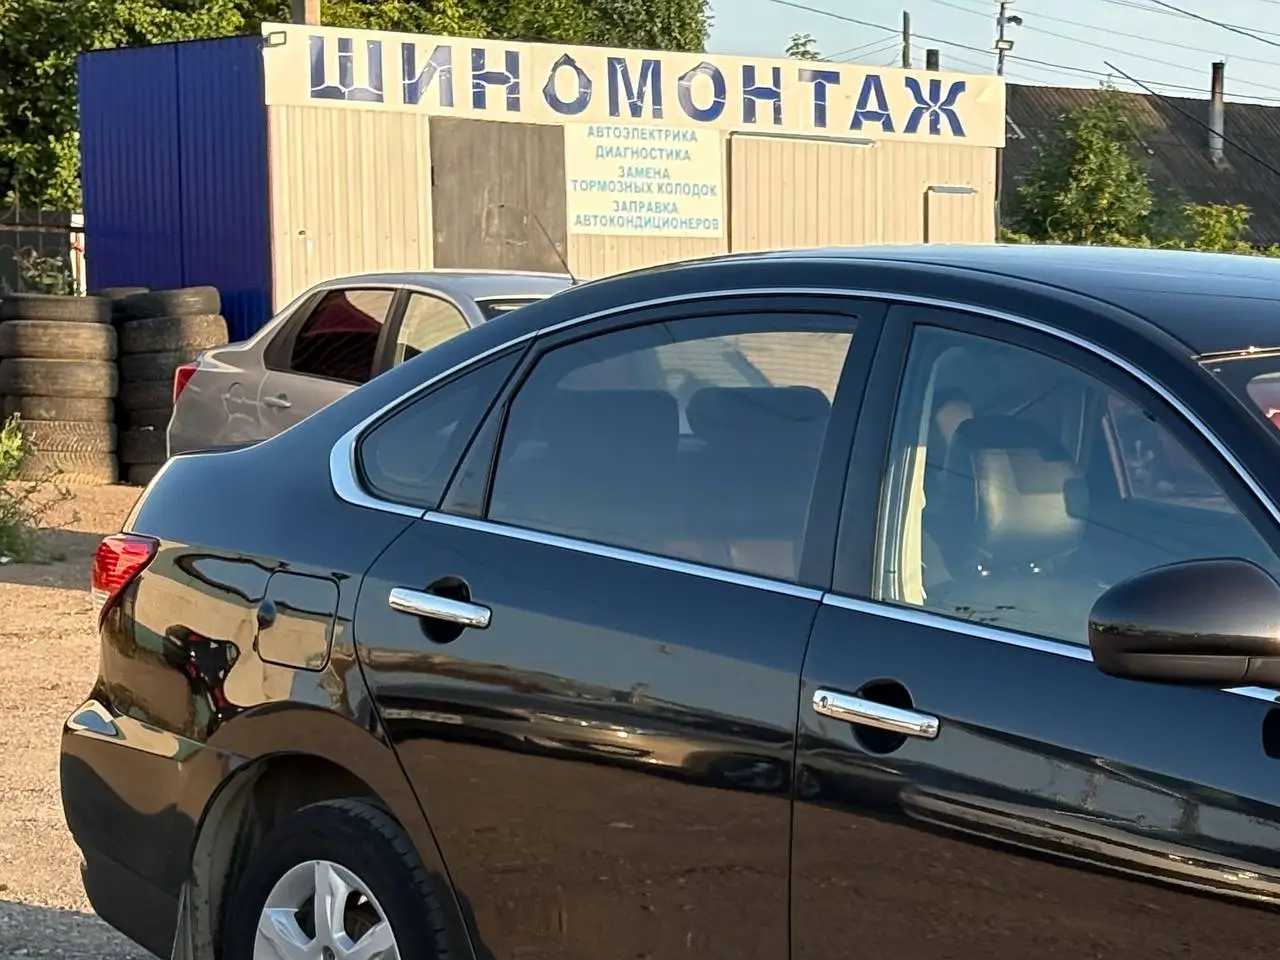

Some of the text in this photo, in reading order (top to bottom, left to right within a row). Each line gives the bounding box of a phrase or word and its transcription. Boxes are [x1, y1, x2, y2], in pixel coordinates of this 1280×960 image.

[308, 34, 967, 138] ШИНОМОНТАЖ
[586, 125, 699, 143] АВТОЭЛЕКТРИКА
[595, 145, 692, 162] ДИАГНОСТИКА
[618, 165, 671, 180] ЗАМЕНА
[571, 179, 718, 199] ТОРМОЗНЫХ КОЛОДОК
[612, 200, 680, 215] ЗАПРАВКА
[574, 213, 720, 231] АВТОКОНДИЦИОНЕРОВ
